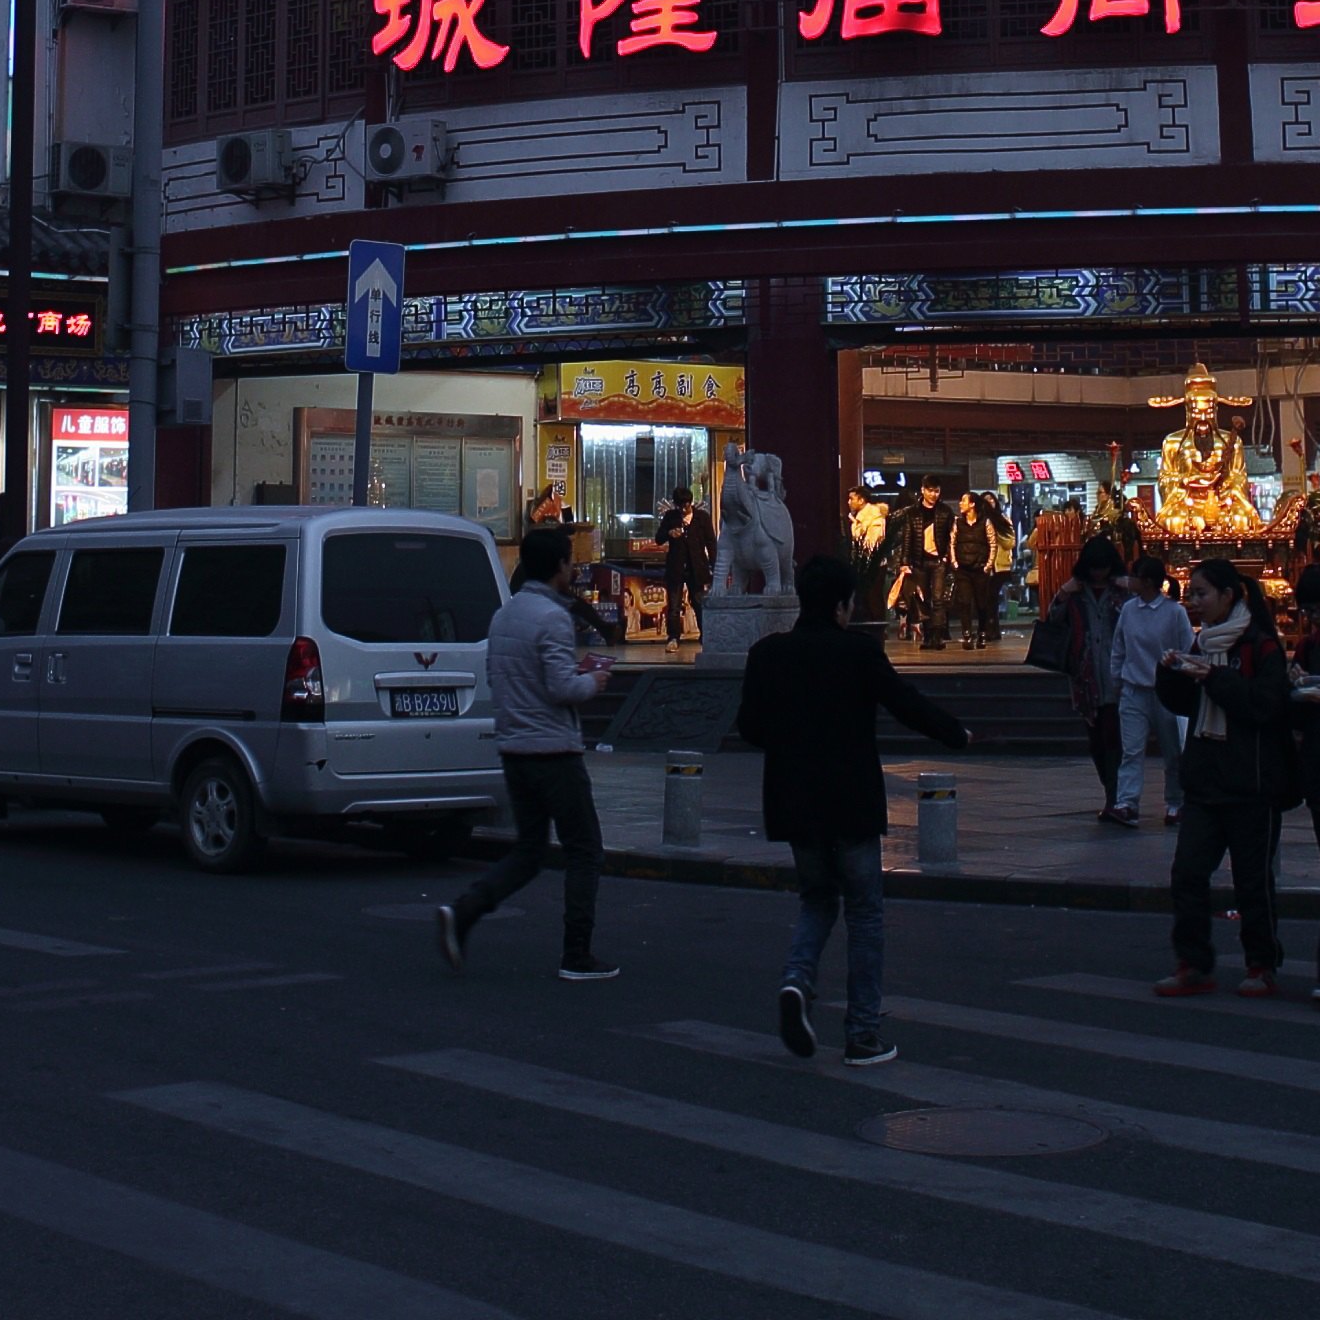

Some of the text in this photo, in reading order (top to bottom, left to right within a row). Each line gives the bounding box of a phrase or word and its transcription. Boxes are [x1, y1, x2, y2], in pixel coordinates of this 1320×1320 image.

[368, 287, 382, 345] 单行线
[624, 370, 722, 399] 高高副食
[61, 414, 127, 435] 儿童服饰
